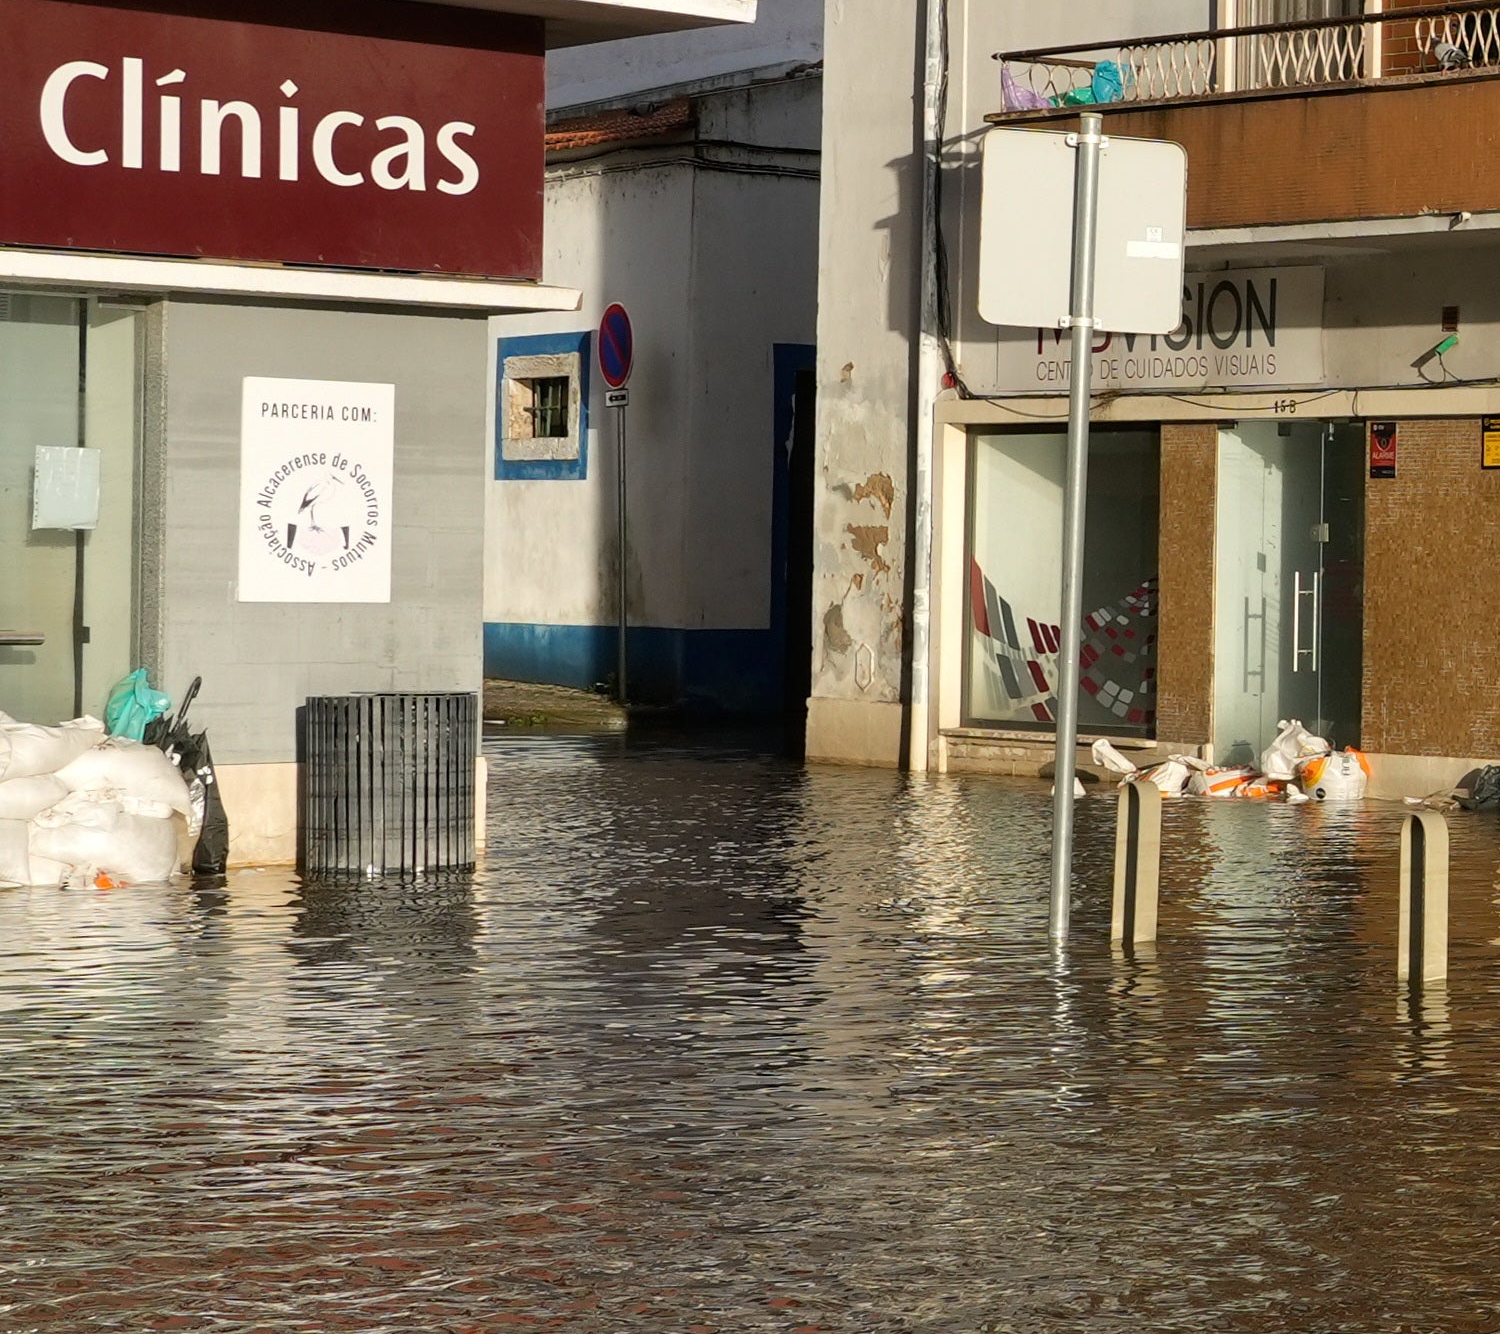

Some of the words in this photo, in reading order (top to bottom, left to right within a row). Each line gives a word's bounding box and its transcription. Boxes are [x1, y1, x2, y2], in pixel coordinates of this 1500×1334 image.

[39, 56, 480, 196] Clínicas
[1100, 358, 1119, 380] DE
[1124, 355, 1209, 379] CUIDADOS
[1214, 354, 1277, 376] VISUAIS
[261, 402, 334, 420] PARCERIA
[341, 406, 377, 423] COM:
[256, 452, 327, 509] Alcacerense
[331, 452, 349, 471] de
[349, 463, 379, 527] Socorros
[257, 514, 316, 577] Associação
